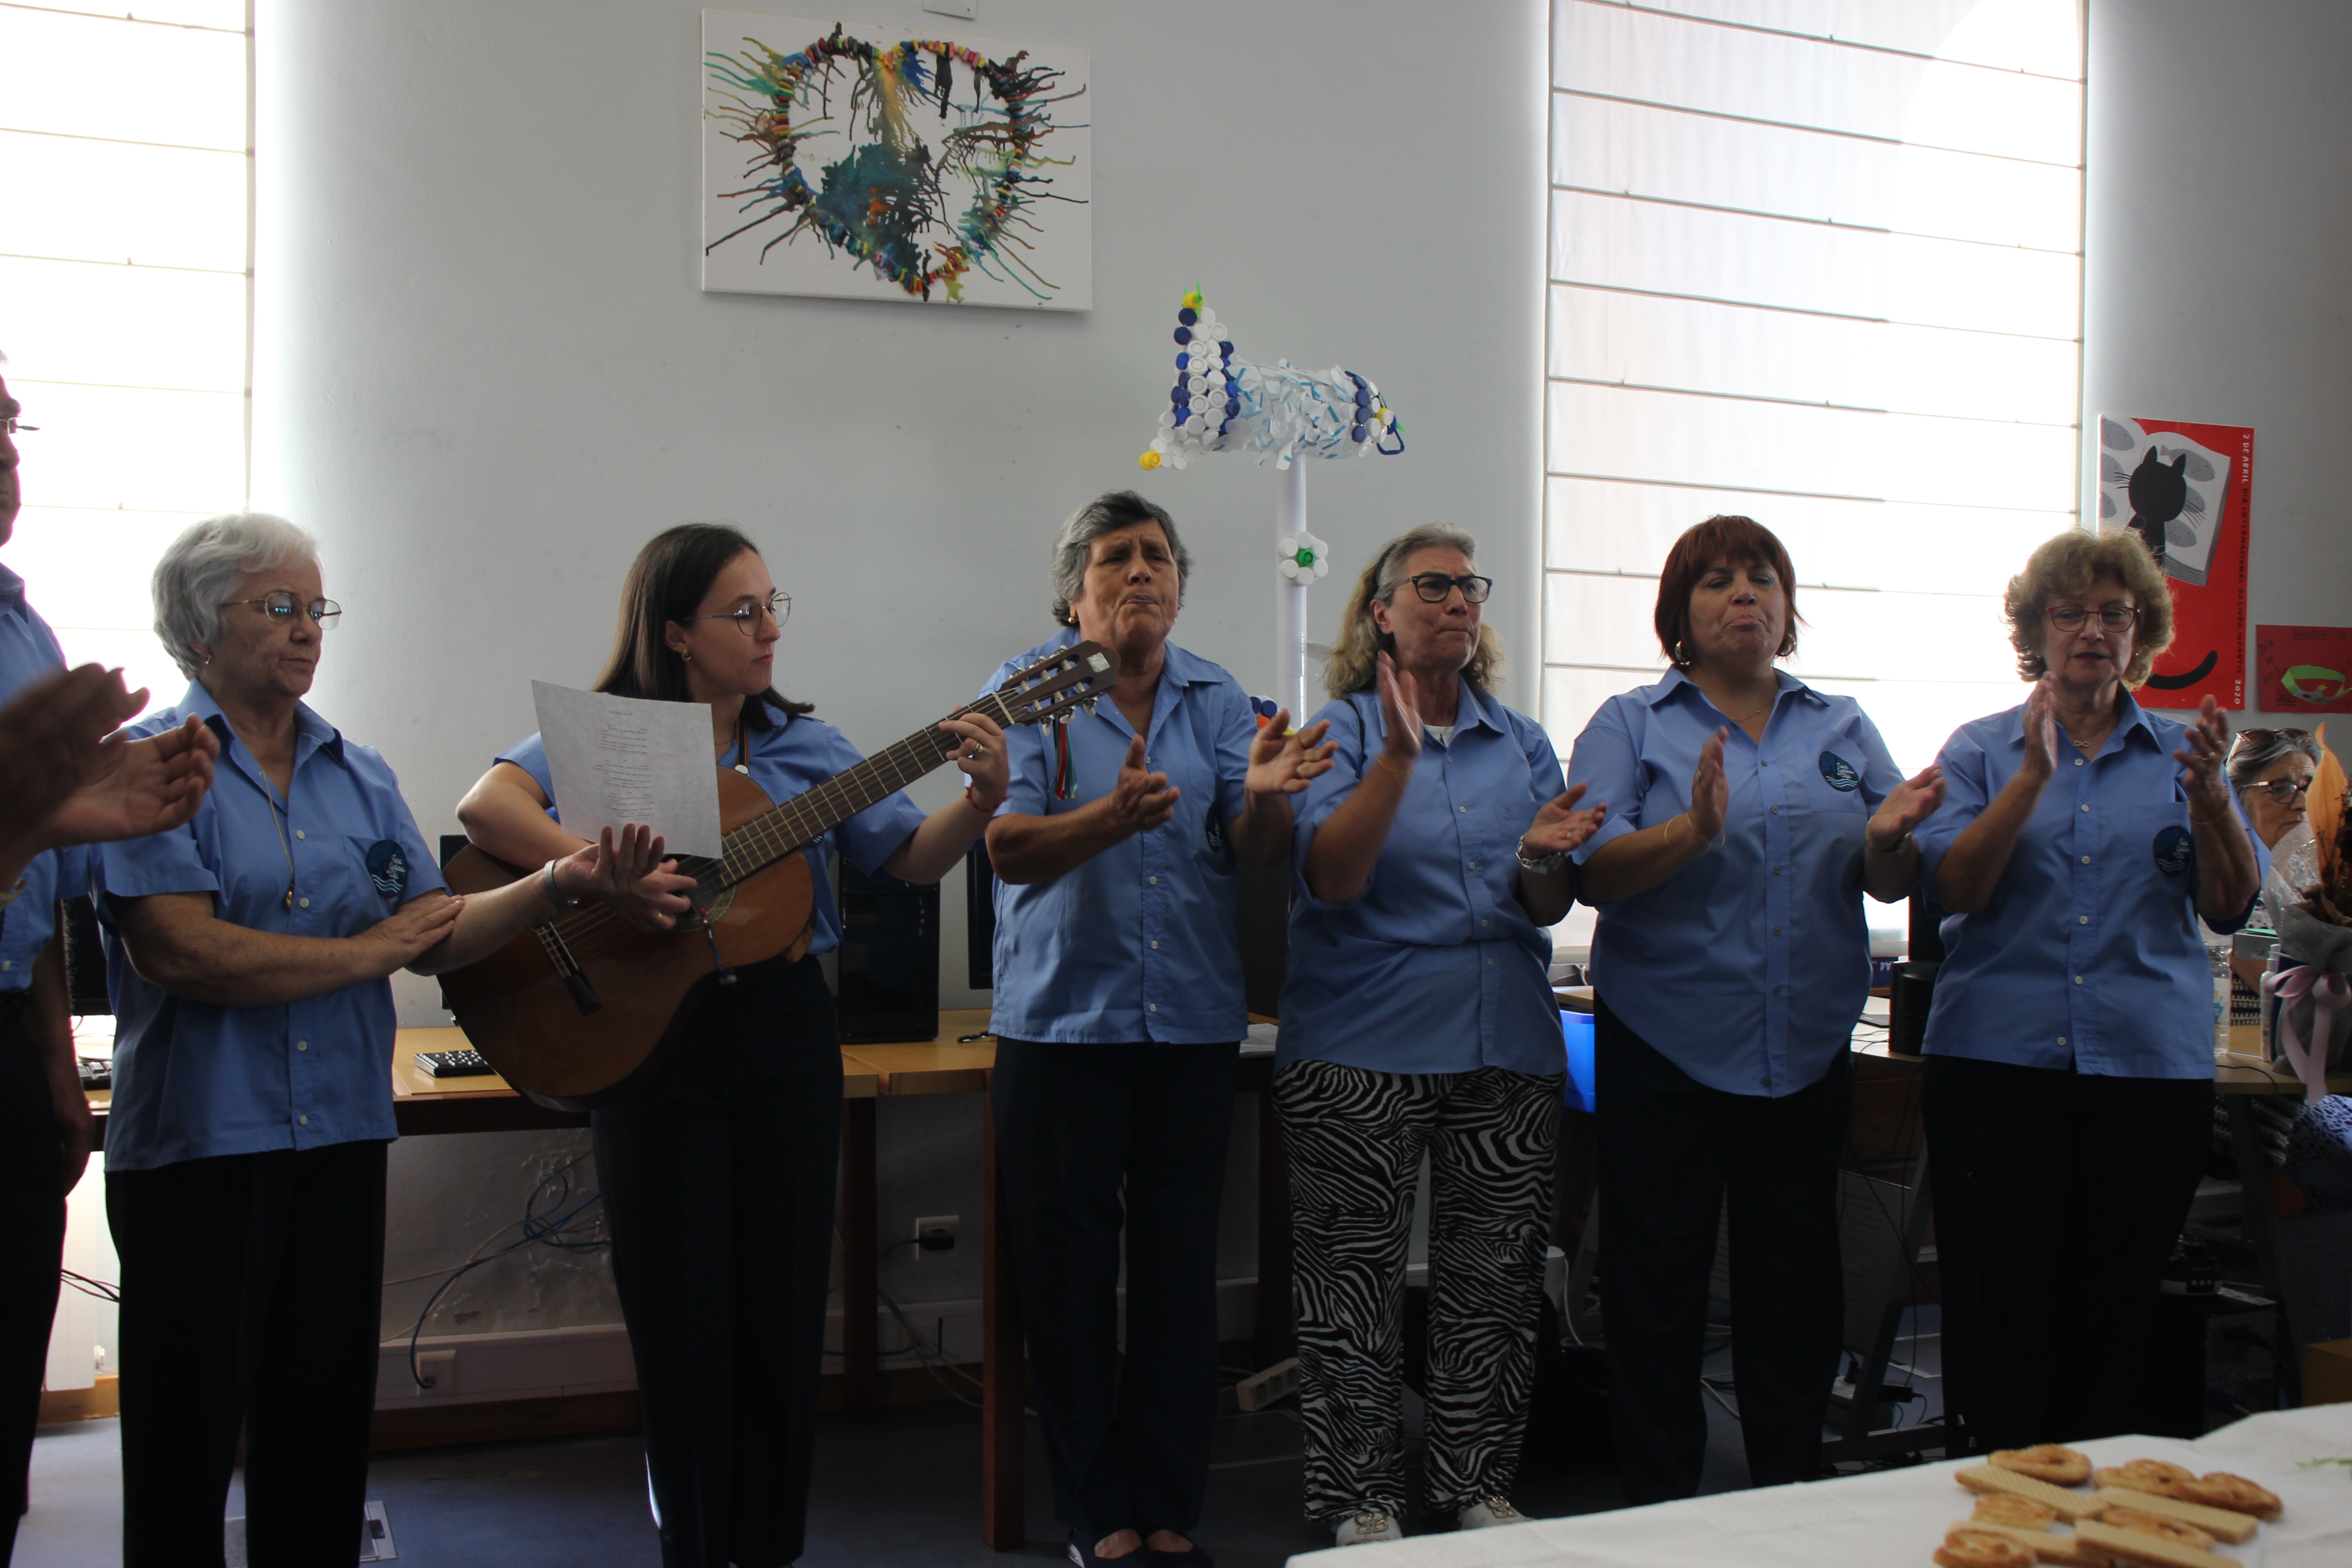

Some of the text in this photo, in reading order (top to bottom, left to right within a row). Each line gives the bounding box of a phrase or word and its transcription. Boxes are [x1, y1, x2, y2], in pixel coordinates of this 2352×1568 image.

[2243, 442, 2249, 453] DE
[2239, 507, 2247, 583] INTERNACIONAL
[2238, 588, 2244, 599] DO
[1880, 961, 1892, 971] A4
